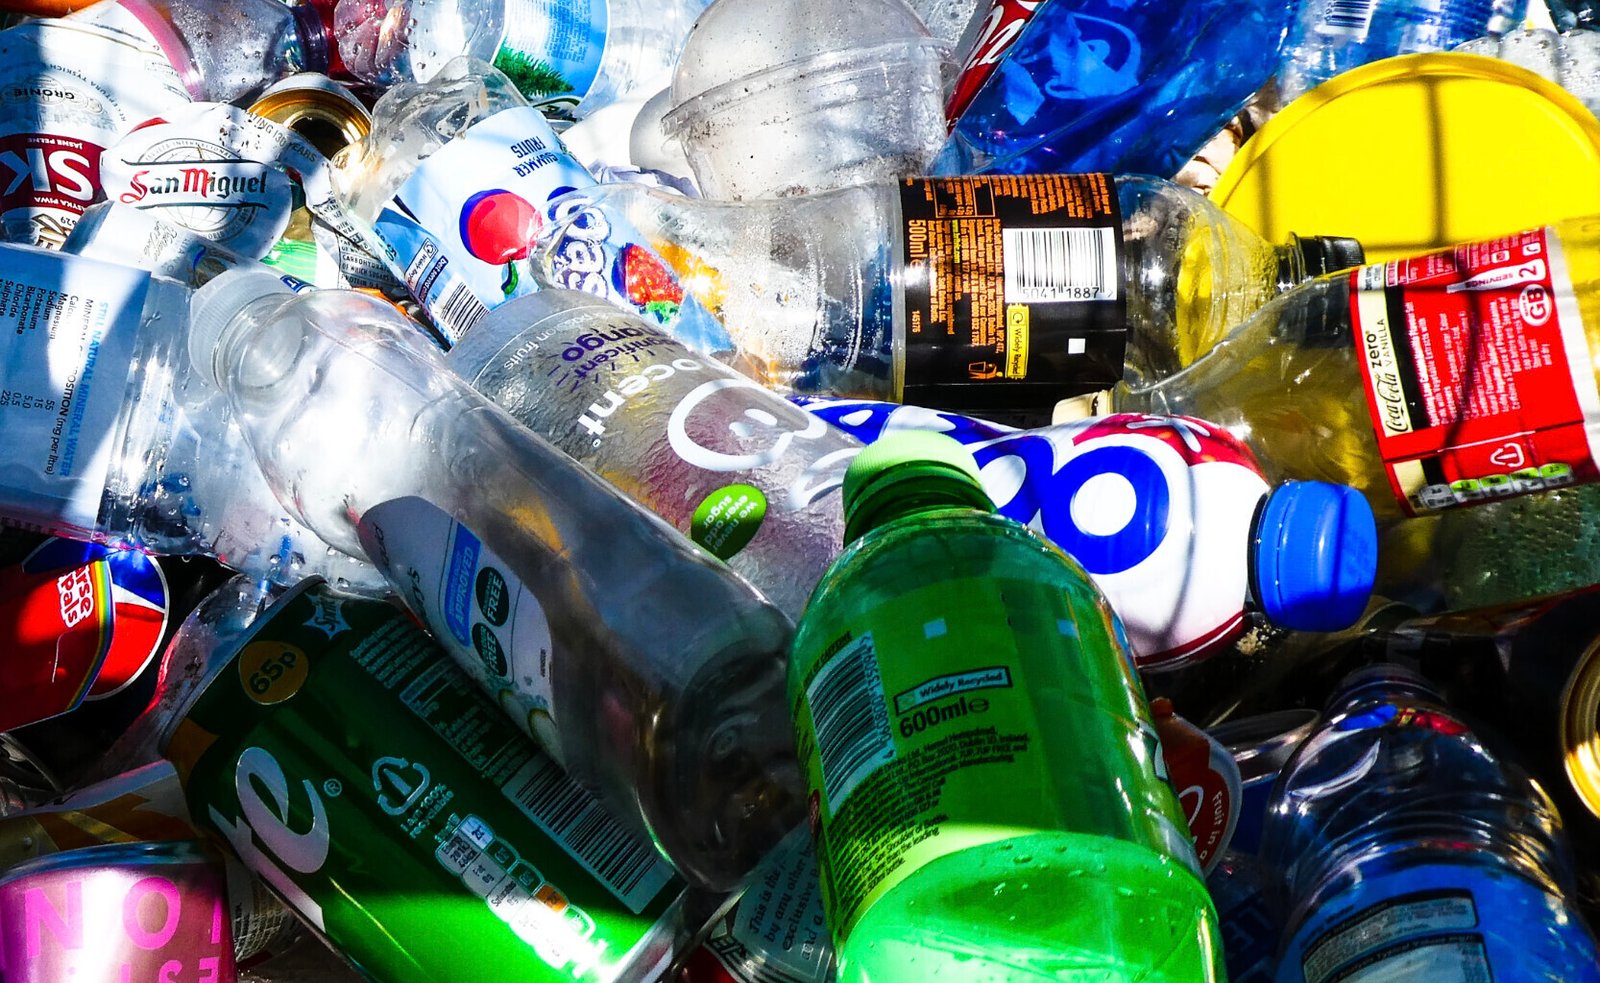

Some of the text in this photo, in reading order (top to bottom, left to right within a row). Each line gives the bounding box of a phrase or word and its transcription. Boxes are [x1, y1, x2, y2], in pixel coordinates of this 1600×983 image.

[511, 135, 548, 160] FRUITS
[513, 152, 559, 178] SUMMER
[119, 167, 267, 204] San Miguel
[907, 219, 927, 258] 500ml
[1519, 265, 1536, 279] 2
[0, 279, 13, 317] Sulphate
[8, 282, 24, 318] Chloride
[15, 284, 35, 335] Bicarbonate
[1066, 287, 1100, 299] 1887
[1530, 288, 1546, 320] GB
[1013, 328, 1021, 352] Widely
[1377, 317, 1395, 366] VANILLA
[1417, 317, 1428, 332] with
[10, 287, 46, 406] Potassium 0.5
[21, 289, 57, 409] Sodium 5.0
[33, 291, 68, 408] Magnesium 15
[503, 334, 540, 371] fruits
[1363, 332, 1383, 369] zero
[1419, 332, 1433, 359] Extracts
[59, 299, 109, 477] STILL NATURAL MINERAL WATER
[1421, 382, 1432, 397] Low
[1426, 359, 1441, 392] Vegetable
[44, 399, 55, 411] 55
[1424, 396, 1440, 426] Sparkling
[44, 416, 65, 476] (mg per litre)
[703, 495, 732, 528] sugar
[703, 494, 748, 545] ever add
[711, 501, 757, 552] we never
[454, 545, 475, 625] APPROVED
[487, 574, 504, 620] FREE
[487, 631, 500, 670] FREE
[249, 649, 297, 695] 65p
[919, 672, 1003, 699] Widely Recycled
[900, 699, 968, 738] 600ml
[404, 807, 424, 827] am
[417, 780, 448, 810] 100%
[407, 790, 455, 839] recyclable
[1212, 791, 1224, 826] fruit
[1207, 830, 1220, 845] in
[749, 872, 783, 934] This is the
[763, 861, 807, 943] by any other
[782, 884, 816, 950] exclusive
